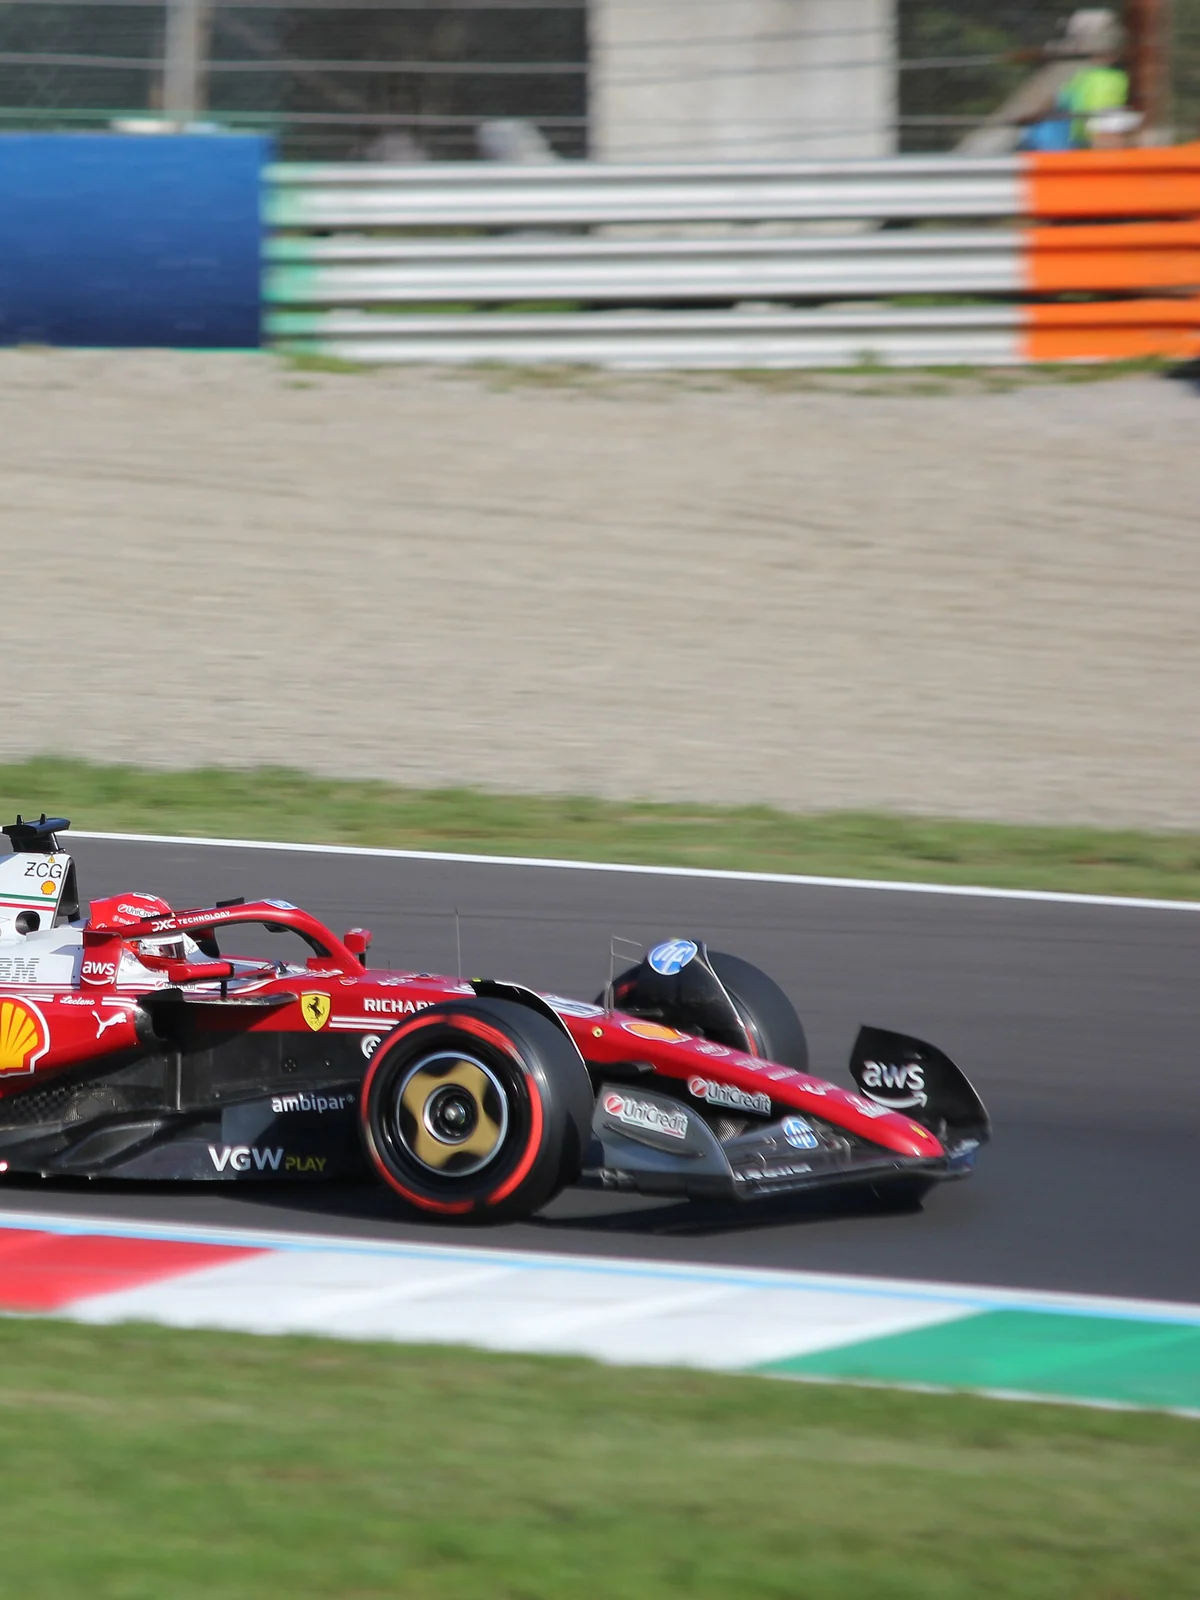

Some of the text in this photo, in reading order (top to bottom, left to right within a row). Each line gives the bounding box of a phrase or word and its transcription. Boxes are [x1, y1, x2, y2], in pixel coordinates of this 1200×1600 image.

[24, 862, 62, 878] ZCG
[177, 910, 231, 925] TECHNOLOGY
[82, 961, 115, 975] aws
[862, 1060, 925, 1091] aws
[708, 1083, 771, 1112] UniCredit
[624, 1100, 688, 1132] UniCredit
[208, 1145, 327, 1172] VGW PLAY
